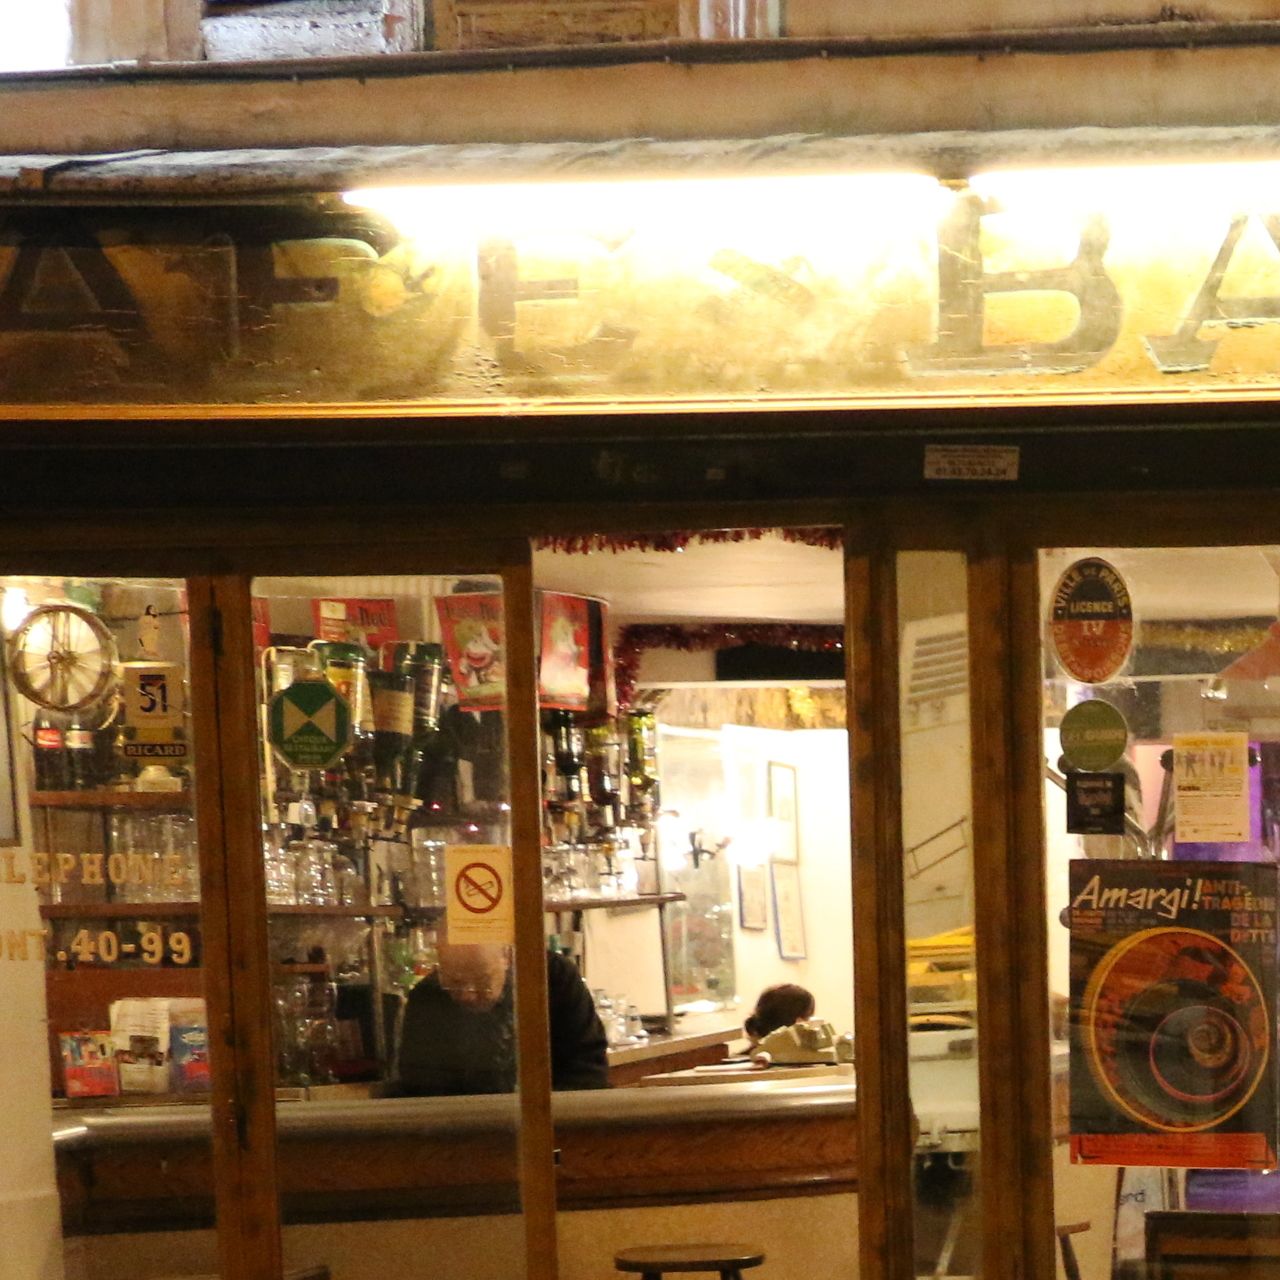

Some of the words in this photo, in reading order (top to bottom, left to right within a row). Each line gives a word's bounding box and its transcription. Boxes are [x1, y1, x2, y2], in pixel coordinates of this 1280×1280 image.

[1069, 600, 1114, 613] LICENCE
[138, 682, 169, 713] 51
[126, 745, 185, 756] RICARD
[1072, 874, 1202, 920] Amargi!
